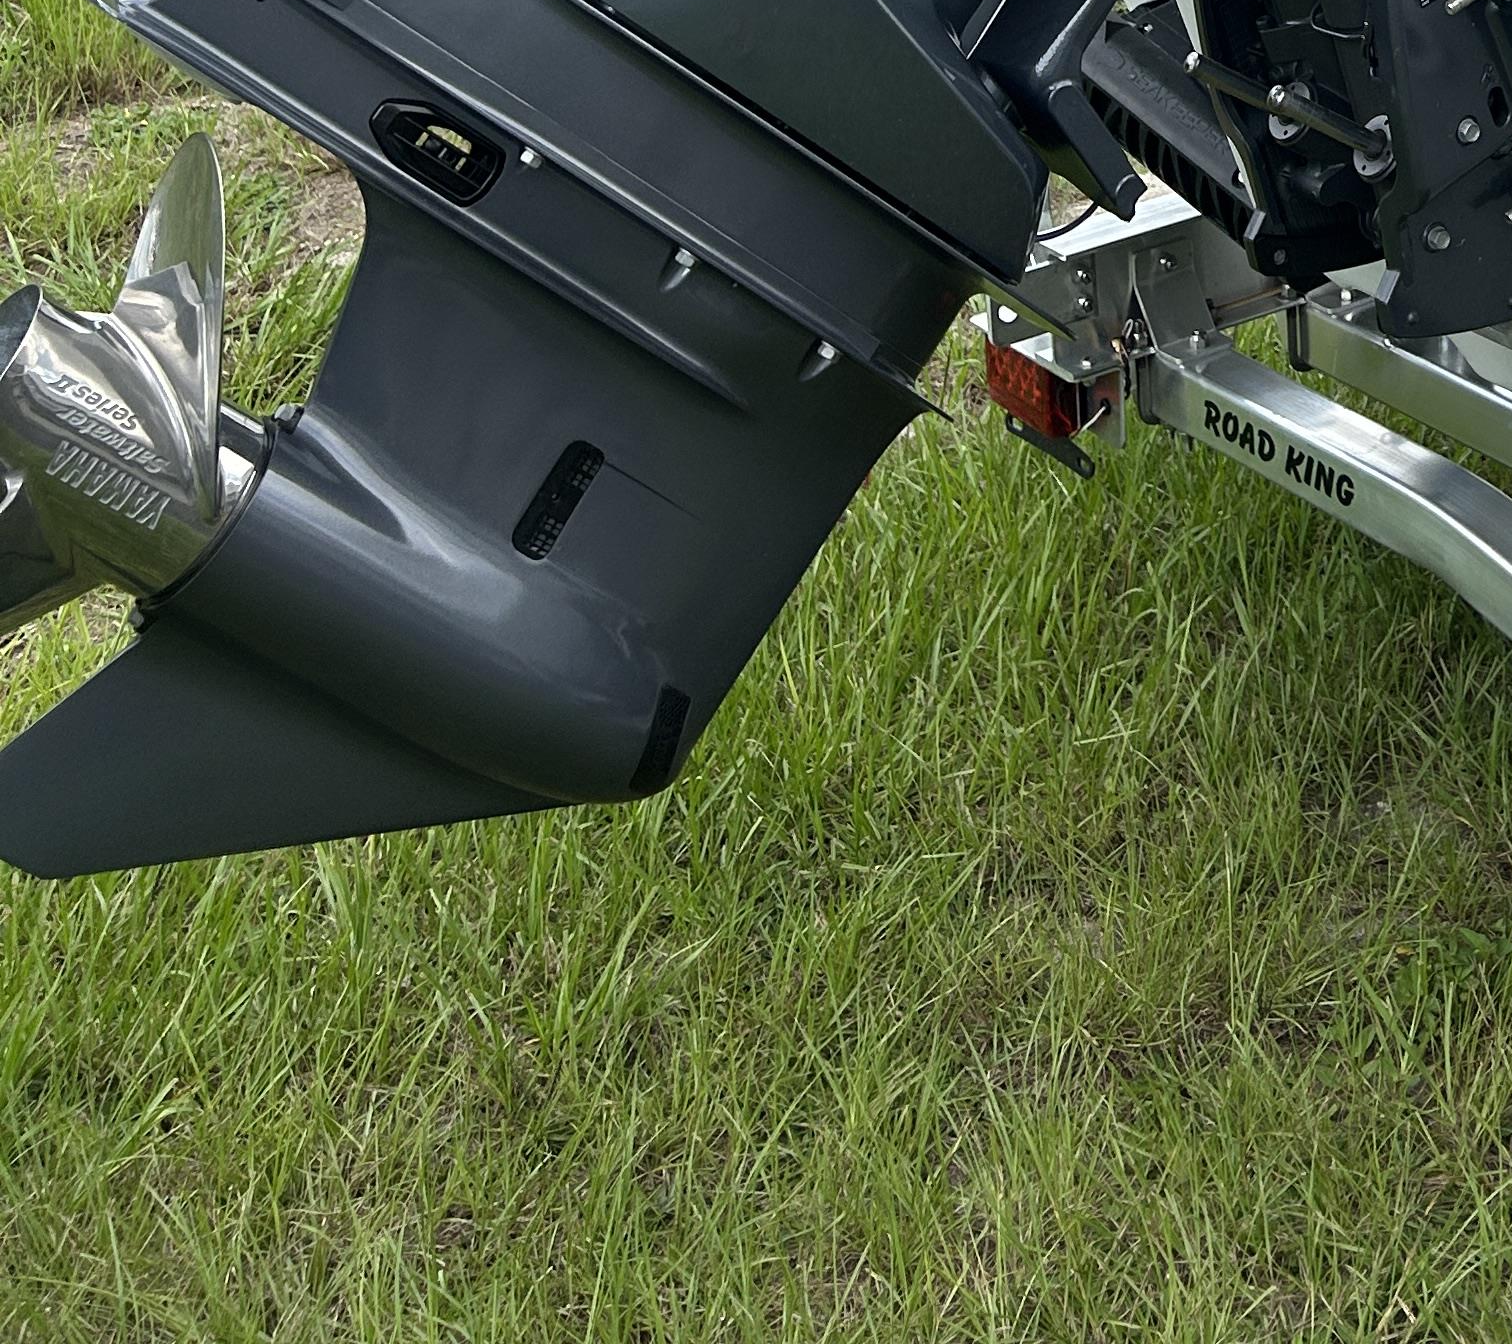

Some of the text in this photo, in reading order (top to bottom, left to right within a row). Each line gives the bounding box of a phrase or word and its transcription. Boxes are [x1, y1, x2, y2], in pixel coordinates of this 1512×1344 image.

[56, 410, 168, 474] Saltwater
[73, 384, 139, 431] Series
[45, 439, 172, 531] YAMAHA
[1204, 399, 1356, 506] ROAD KING
